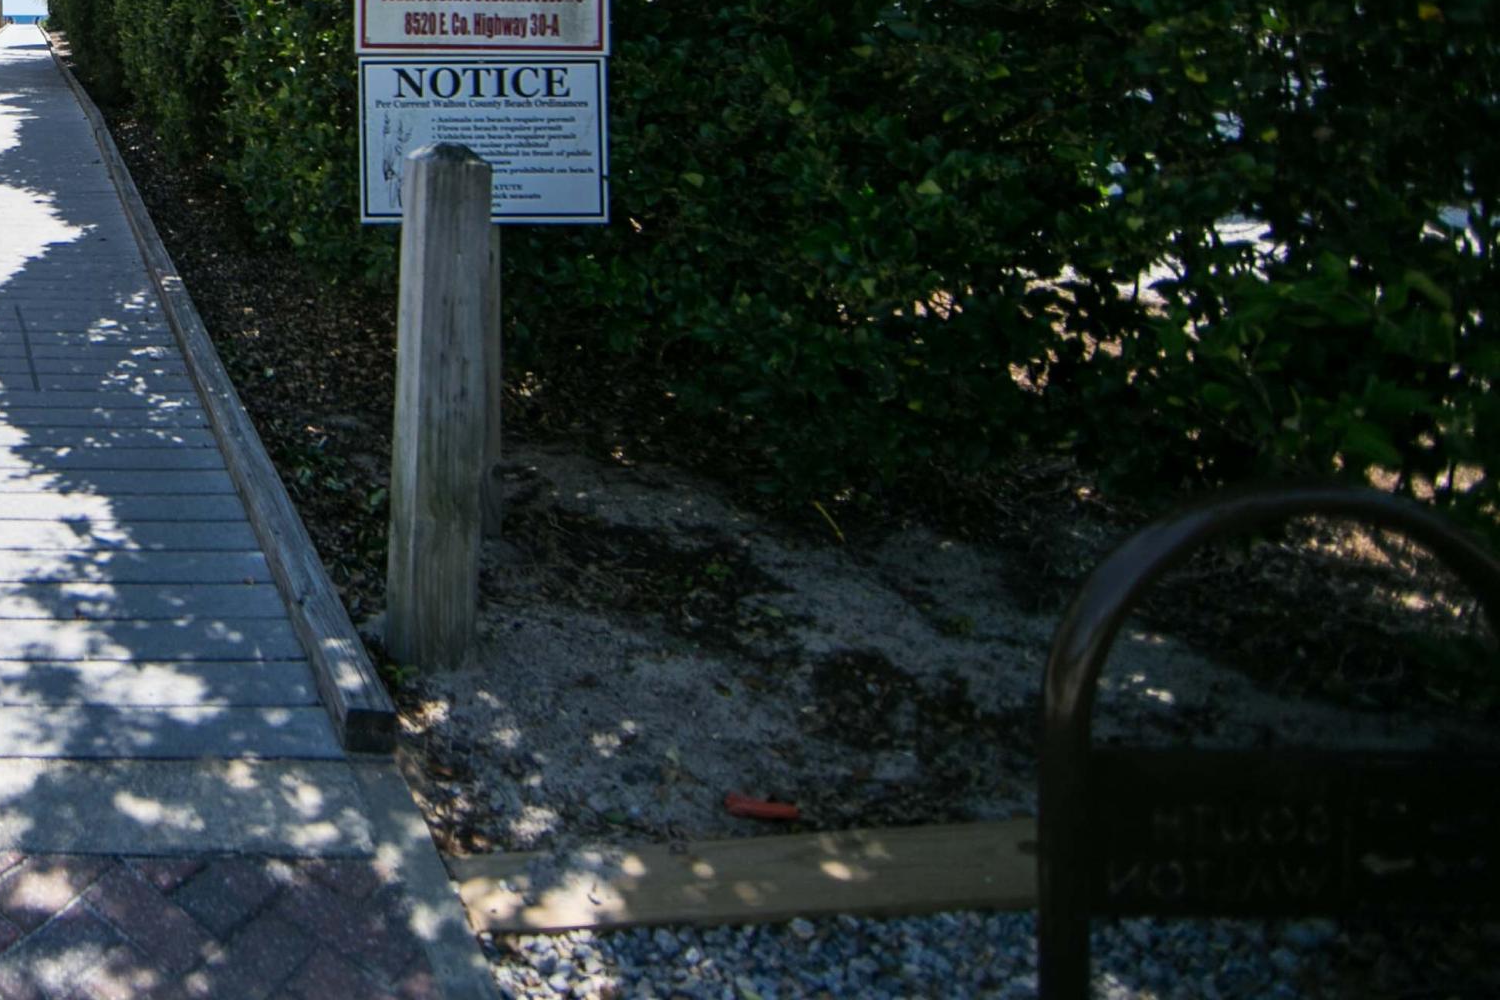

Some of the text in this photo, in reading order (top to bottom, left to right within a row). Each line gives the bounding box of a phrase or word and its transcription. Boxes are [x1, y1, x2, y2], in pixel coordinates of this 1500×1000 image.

[404, 12, 436, 35] 8520
[473, 12, 527, 39] Highway
[530, 13, 560, 37] 30-A
[393, 67, 571, 98] NOTICE
[375, 98, 589, 109] Per Current Walton County Beach Ordinances
[546, 116, 576, 124] permit
[547, 133, 577, 141] permit
[569, 166, 595, 174] beach
